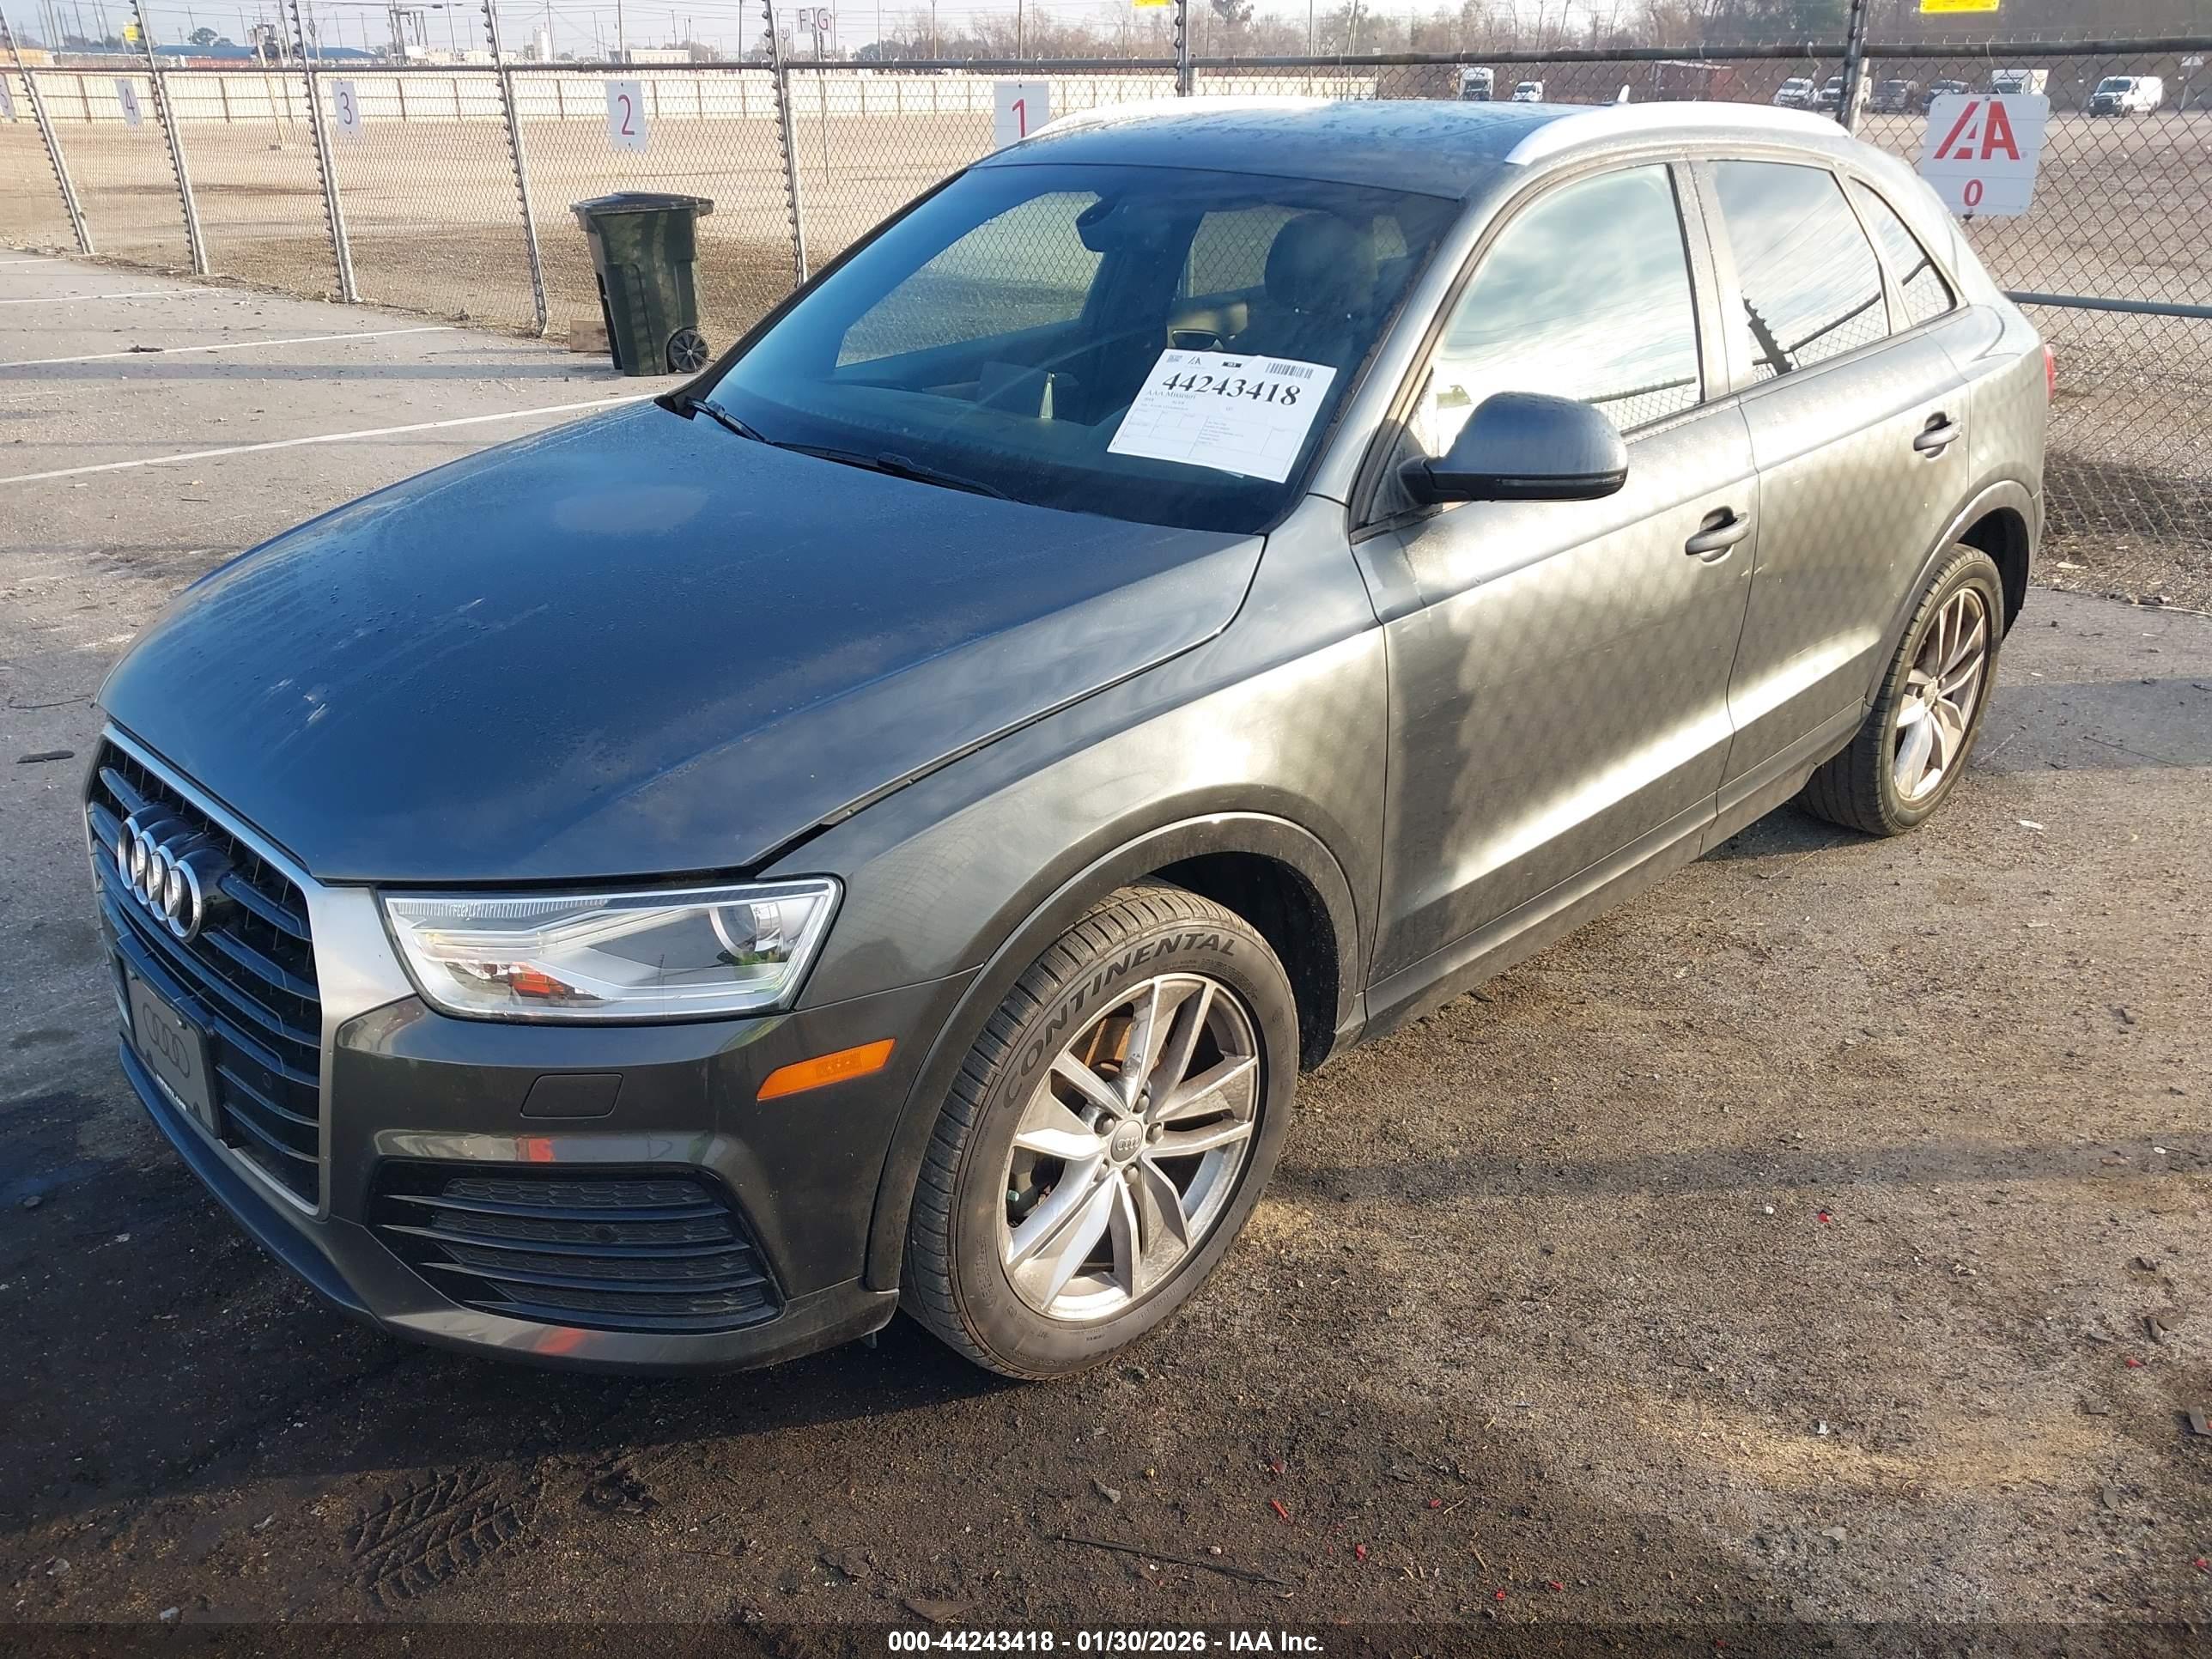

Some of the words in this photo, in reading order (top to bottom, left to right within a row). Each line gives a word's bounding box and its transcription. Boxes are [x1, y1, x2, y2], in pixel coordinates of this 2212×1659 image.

[799, 9, 807, 32] F
[817, 9, 829, 31] G
[125, 88, 135, 116] 4
[339, 91, 352, 125] 3
[617, 94, 635, 136] 2
[1012, 98, 1026, 138] 1
[1963, 179, 1983, 207] 0
[1161, 370, 1302, 407] 44243418
[1003, 932, 1237, 1109] CONTINENTAL
